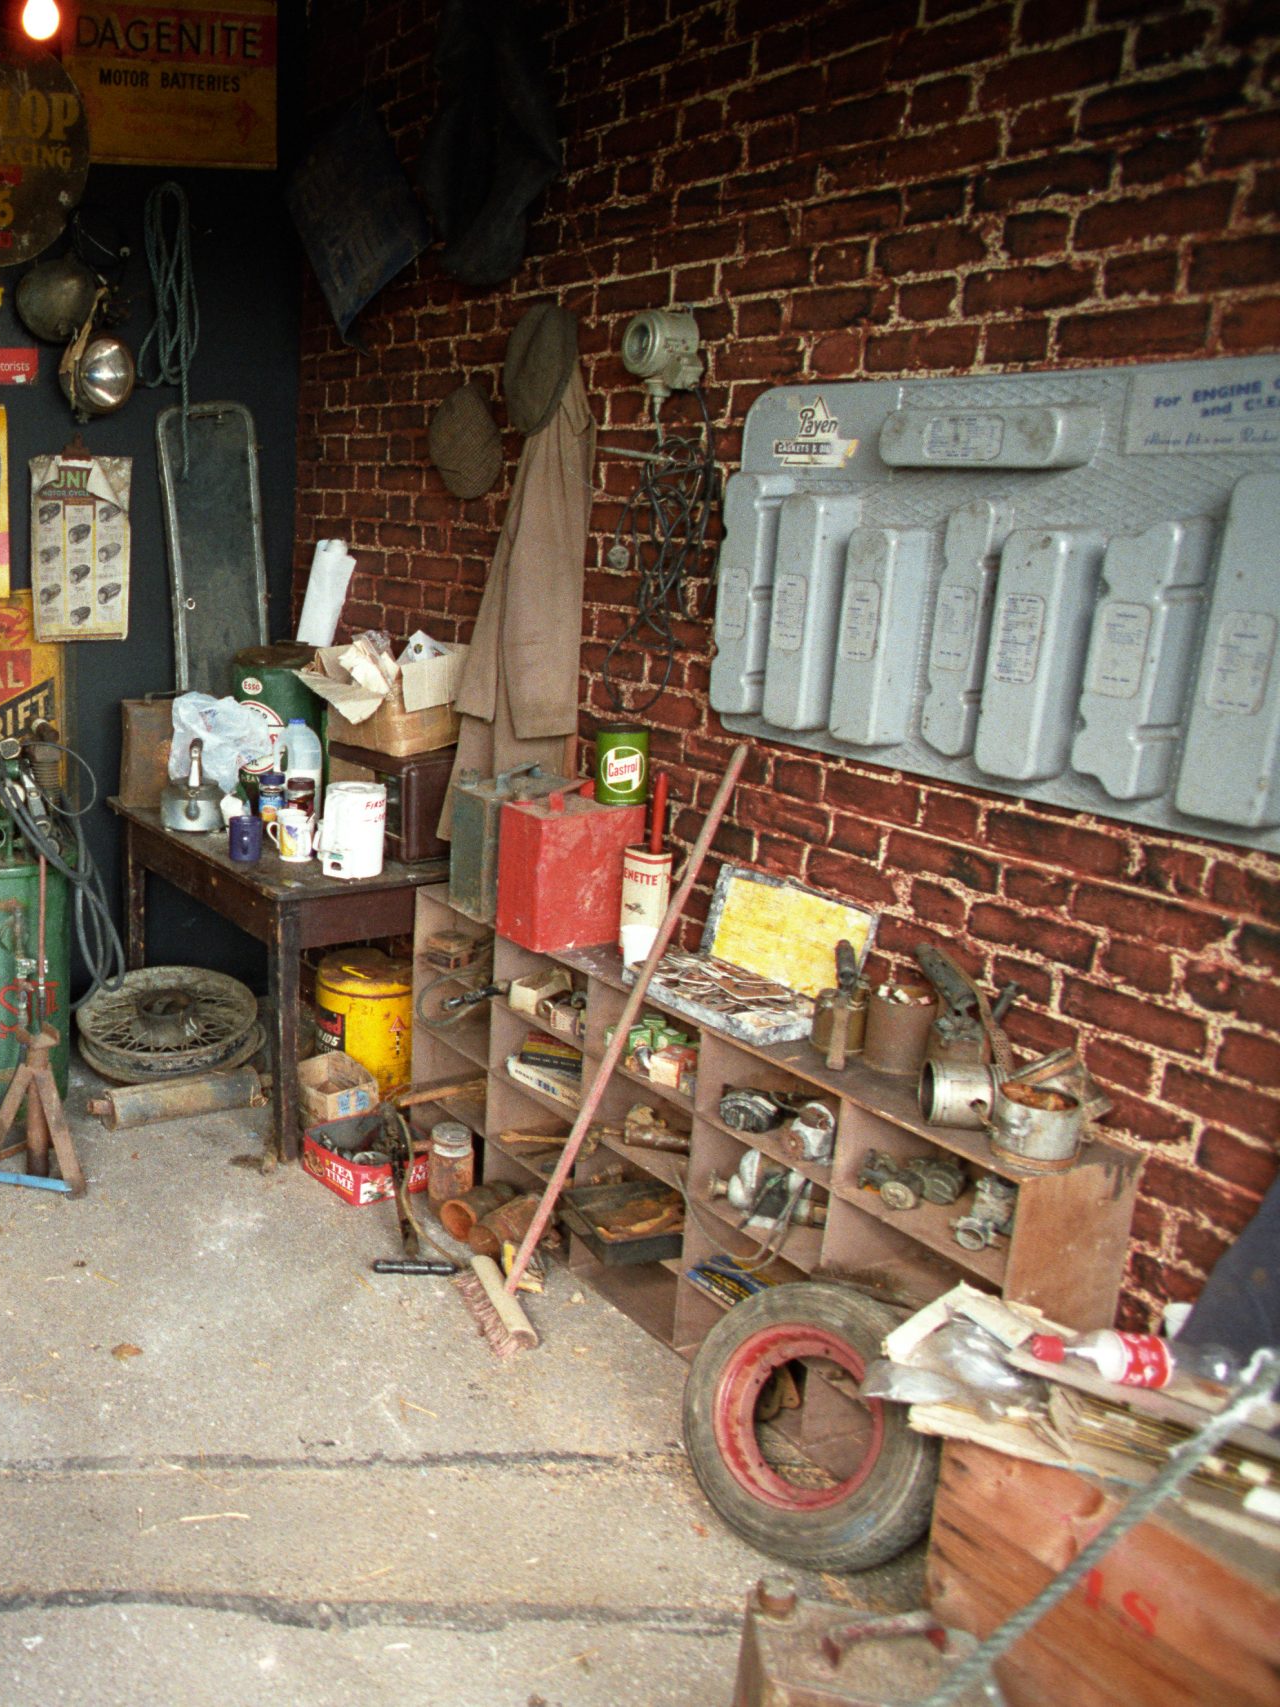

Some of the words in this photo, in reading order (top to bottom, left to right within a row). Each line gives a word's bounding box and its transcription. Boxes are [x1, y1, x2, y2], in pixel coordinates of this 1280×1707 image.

[76, 15, 263, 58] DAGENITE
[99, 68, 149, 89] MOTOR
[160, 70, 241, 93] BATTERIES
[1191, 380, 1262, 403] ENGINE
[799, 408, 838, 437] Payen
[607, 757, 638, 778] Castrol
[325, 1167, 355, 1192] TIME
[330, 1161, 354, 1181] TEA
